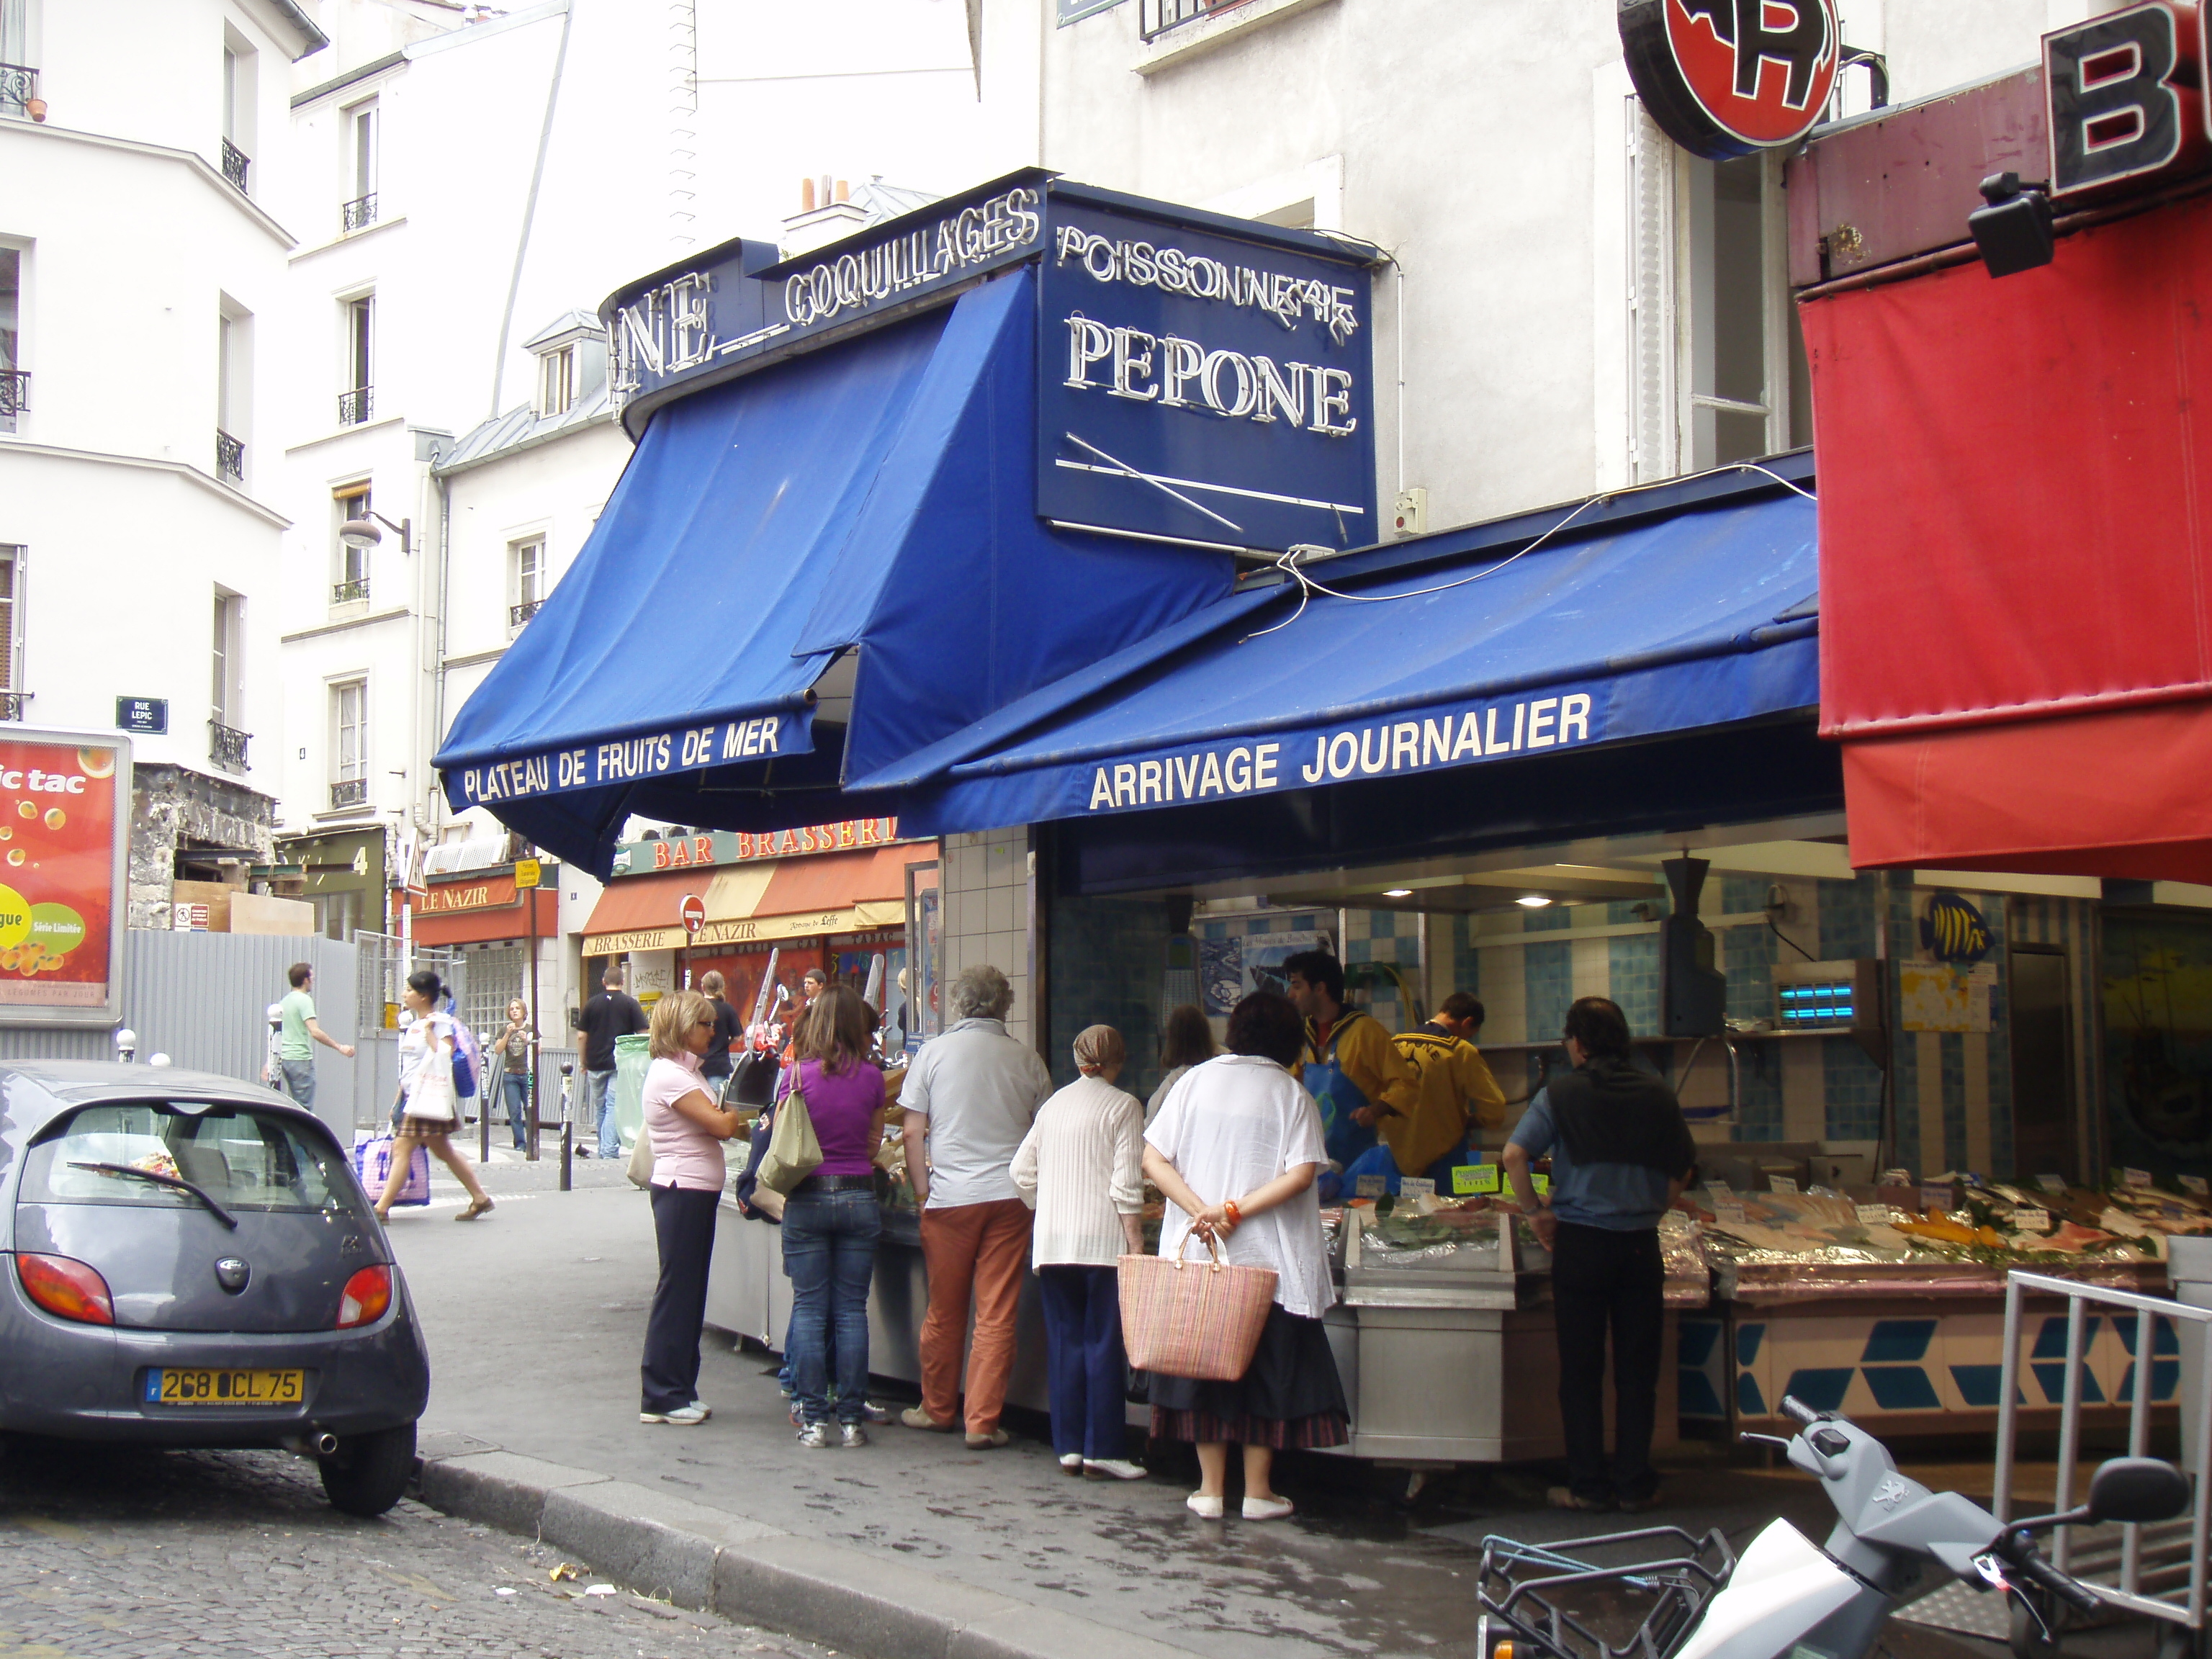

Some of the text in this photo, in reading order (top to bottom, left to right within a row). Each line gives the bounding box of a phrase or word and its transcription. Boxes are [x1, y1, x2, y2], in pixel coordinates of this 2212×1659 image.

[2041, 0, 2212, 197] B
[785, 188, 1040, 326] COQUILLAGES
[1064, 310, 1357, 436] PEPONE
[132, 711, 152, 720] LEPIC
[135, 701, 150, 711] RUE
[464, 716, 779, 803] PLATEAU DE FRUITS DE MER
[1089, 693, 1593, 811] ARRIVAGE JOURNALIER
[28, 769, 86, 794] tac
[354, 846, 368, 876] 4
[652, 835, 714, 869] BAR
[421, 886, 488, 911] LE NAZIR
[34, 921, 81, 934] Série Limitée
[820, 914, 839, 927] Leffe
[594, 931, 666, 953] BRASSERIE
[709, 922, 757, 943] NAZIR
[851, 932, 894, 945] TABAC
[163, 1372, 211, 1398] 268
[269, 1372, 297, 1398] 75
